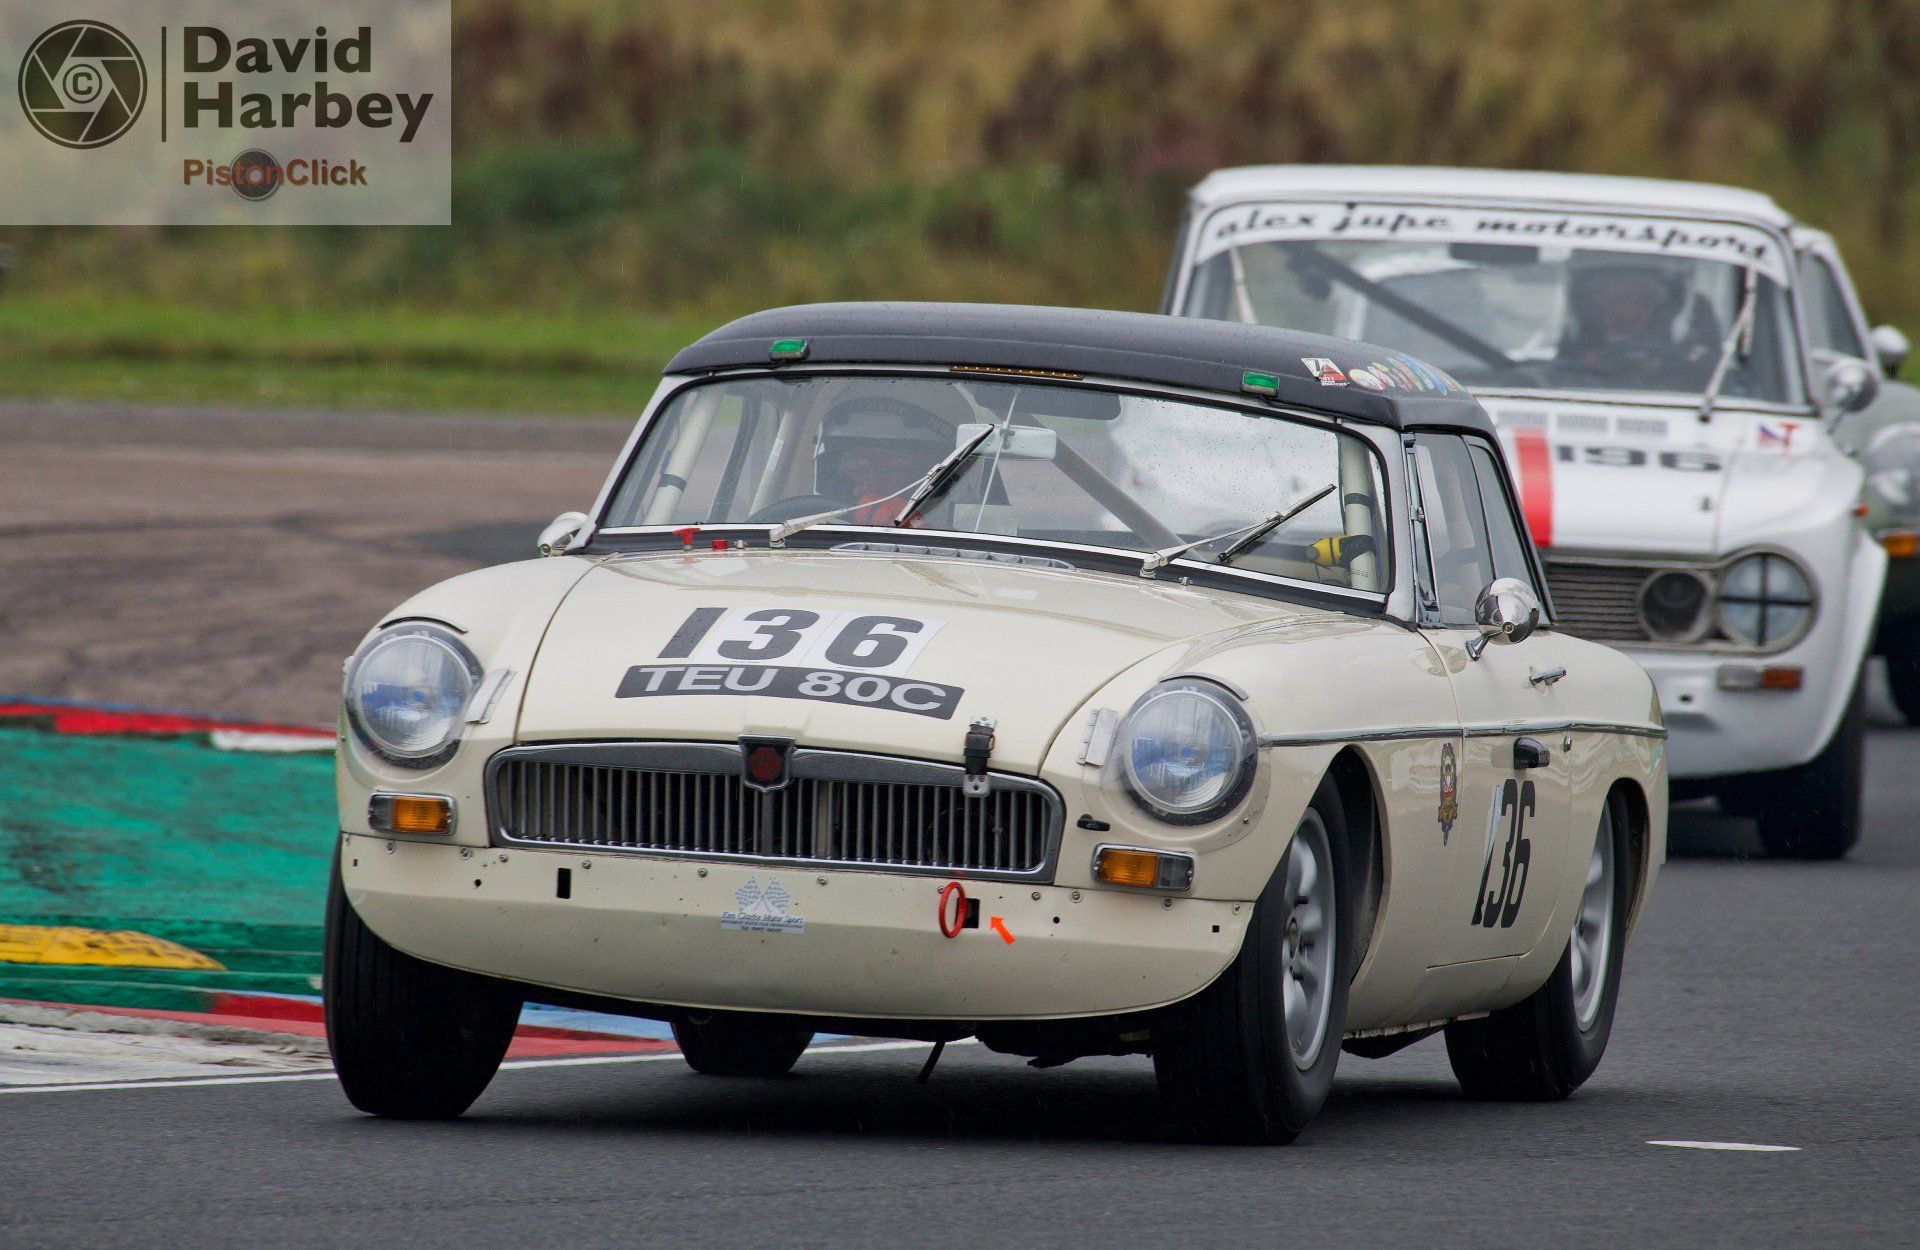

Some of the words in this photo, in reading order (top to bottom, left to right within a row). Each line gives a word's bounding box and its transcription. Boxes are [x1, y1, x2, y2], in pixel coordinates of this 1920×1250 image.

[1216, 208, 1316, 239] alex
[1331, 202, 1449, 235] jupe
[1476, 217, 1770, 261] motorsport
[657, 607, 924, 668] 136
[639, 667, 779, 692] TEU
[798, 672, 947, 711] 80C
[1471, 778, 1536, 929] 136
